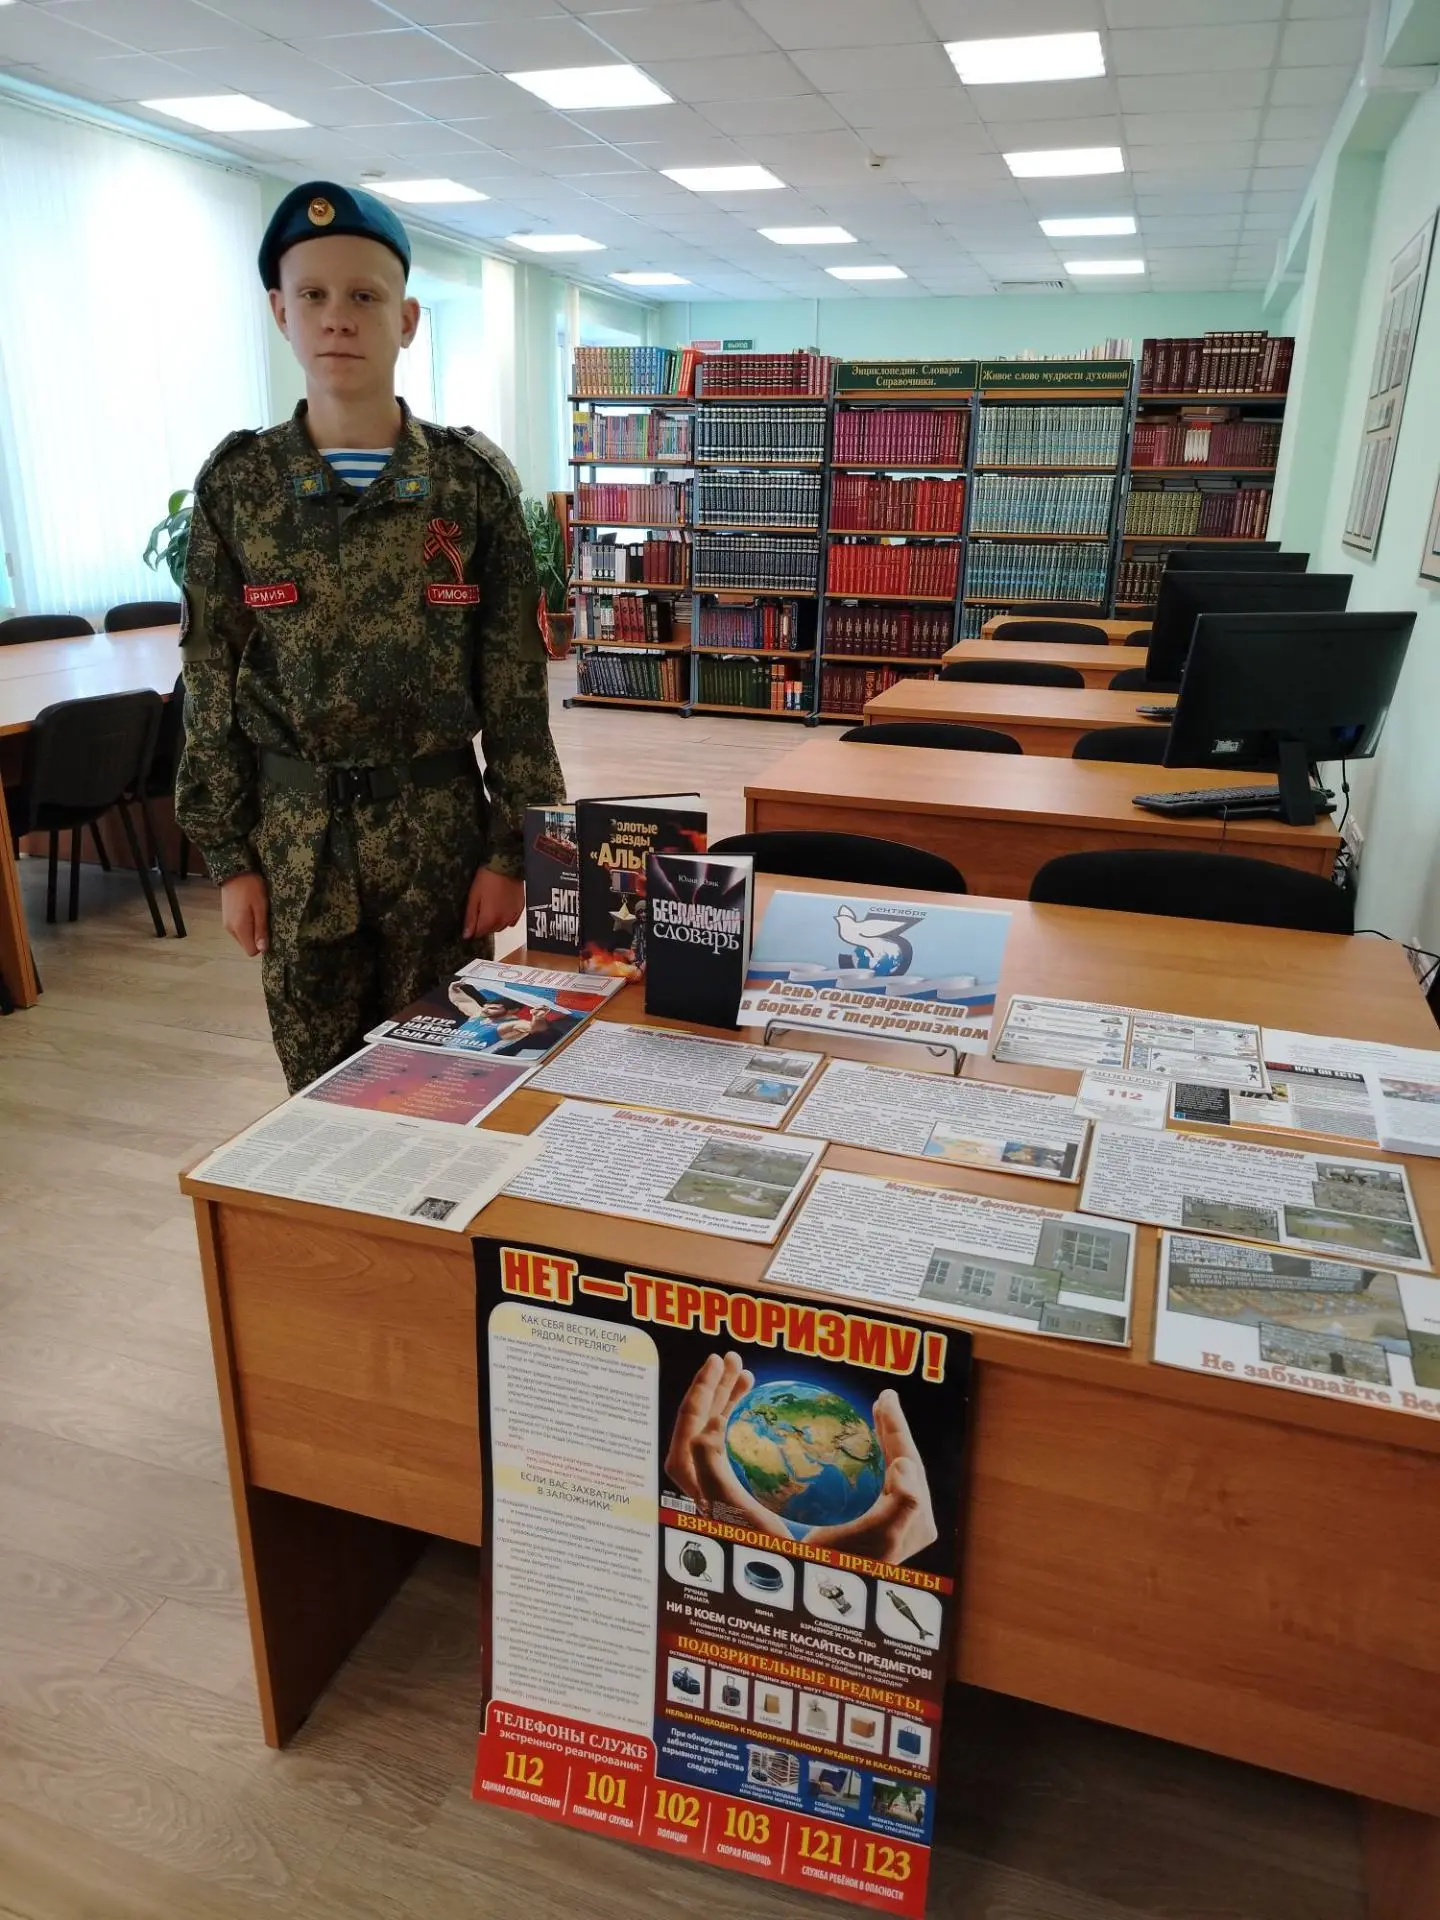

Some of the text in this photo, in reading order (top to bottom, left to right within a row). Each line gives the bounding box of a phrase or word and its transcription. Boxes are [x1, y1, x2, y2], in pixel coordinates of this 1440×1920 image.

[851, 364, 963, 377] Энциклопедии. Словари.
[875, 376, 937, 388] Справочники.
[982, 368, 1128, 383] Живое слово мудрости духовной
[535, 911, 547, 938] ЗА
[653, 898, 741, 934] БЕСЛАНСКИЙ
[869, 906, 927, 917] сентября
[769, 981, 965, 1019] День солидарности
[411, 1015, 457, 1025] АРТУР
[741, 1000, 990, 1041] в борьбе с терроризмом
[1106, 1088, 1144, 1101] 112
[612, 1110, 658, 1124] Школа
[1176, 1133, 1226, 1148] После
[885, 1182, 937, 1198] История
[981, 1200, 1064, 1220] фотографии
[501, 1248, 577, 1304] НЕТ
[521, 1313, 627, 1344] КАК СЕБЯ ВЕСТИ, ЕСЛИ
[531, 1328, 566, 1344] РЯДОМ
[1201, 1351, 1236, 1373] Не
[1244, 1362, 1392, 1405] забывайте
[521, 1471, 630, 1505] ЕСЛИ ВАС ЗАХВАТИЛИ
[537, 1486, 613, 1511] В ЗАЛОЖНИКИ:
[677, 1514, 831, 1562] ВЗРЫВООПАСНЫЕ
[839, 1553, 941, 1591] ПРЕДМЕТЫ
[666, 1601, 682, 1614] НИ
[685, 1607, 692, 1616] В
[694, 1608, 726, 1625] КОЕМ
[728, 1616, 771, 1636] СЛУЧАЕ
[773, 1627, 789, 1640] НЕ
[790, 1632, 856, 1659] КАСАЙТЕСЬ
[858, 1651, 932, 1680] ПРЕДМЕТОВ!
[814, 1620, 863, 1638] САМОДЕЛЬНОЕ
[678, 1636, 828, 1685] ПОДОЗРИТЕЛЬНЫЕ
[829, 1675, 925, 1714] ПРЕДМЕТЫ,
[494, 1709, 648, 1759] ТЕЛЕФОНЫ СЛУЖБ
[665, 1707, 693, 1720] НЕЛЬЗЯ
[694, 1714, 739, 1732] ПОДХОДИТЬ
[740, 1725, 746, 1733] К
[747, 1727, 823, 1753] ПОДОЗРИТЕЛЬНОМУ
[824, 1748, 865, 1765] ПРЕДМЕТУ
[873, 1761, 912, 1777] КАСАТЬСЯ
[670, 1728, 686, 1738] При
[499, 1729, 643, 1772] экстренного реагирования:
[662, 1746, 745, 1772] взрывного устройства
[700, 1746, 725, 1758] вещей
[725, 1753, 740, 1761] или
[503, 1751, 544, 1787] 112
[482, 1780, 561, 1809] ЕДИНАЯ СЛУЖБА СПАСЕНИЯ
[584, 1771, 627, 1809] 101
[573, 1804, 634, 1828] ПОЖАРНАЯ СЛУЖБА
[655, 1790, 700, 1828] 102
[657, 1827, 688, 1843] ПОЛИЦИЯ
[724, 1807, 770, 1844] 103
[717, 1843, 771, 1867] СКОРАЯ ПОМОЩЬ
[798, 1826, 842, 1866] 121
[863, 1842, 911, 1881] 123
[802, 1865, 829, 1881] СЛУЖБА
[859, 1880, 864, 1890] В
[865, 1882, 905, 1900] ОПАСНОСТИ
